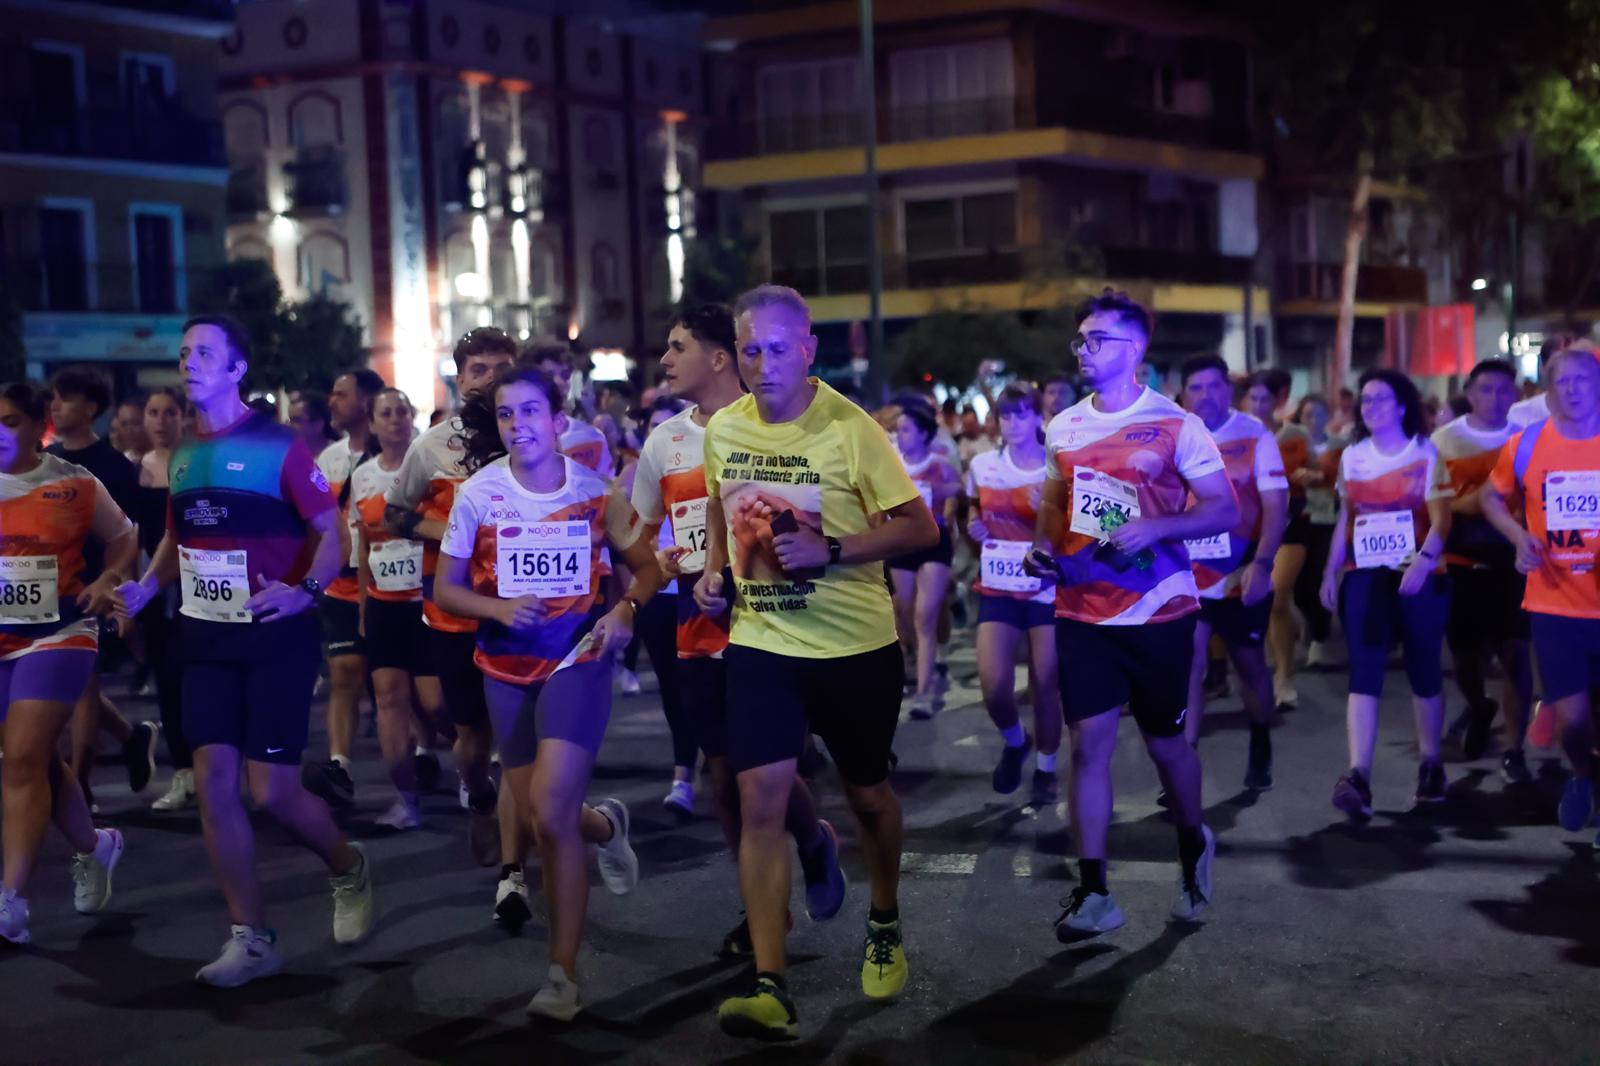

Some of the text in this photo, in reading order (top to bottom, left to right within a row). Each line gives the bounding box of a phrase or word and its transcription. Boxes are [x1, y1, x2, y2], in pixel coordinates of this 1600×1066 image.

[726, 452, 810, 469] JUAN ya no habla,
[739, 470, 752, 480] su
[753, 469, 792, 483] historia
[794, 470, 821, 485] grita
[1555, 495, 1600, 512] 1629
[1361, 533, 1407, 552] 10053
[379, 559, 416, 577] 2473
[508, 552, 579, 576] 15614
[988, 560, 1030, 577] 1932
[0, 583, 41, 605] 885
[193, 576, 233, 602] 2896
[777, 598, 807, 611] vidas
